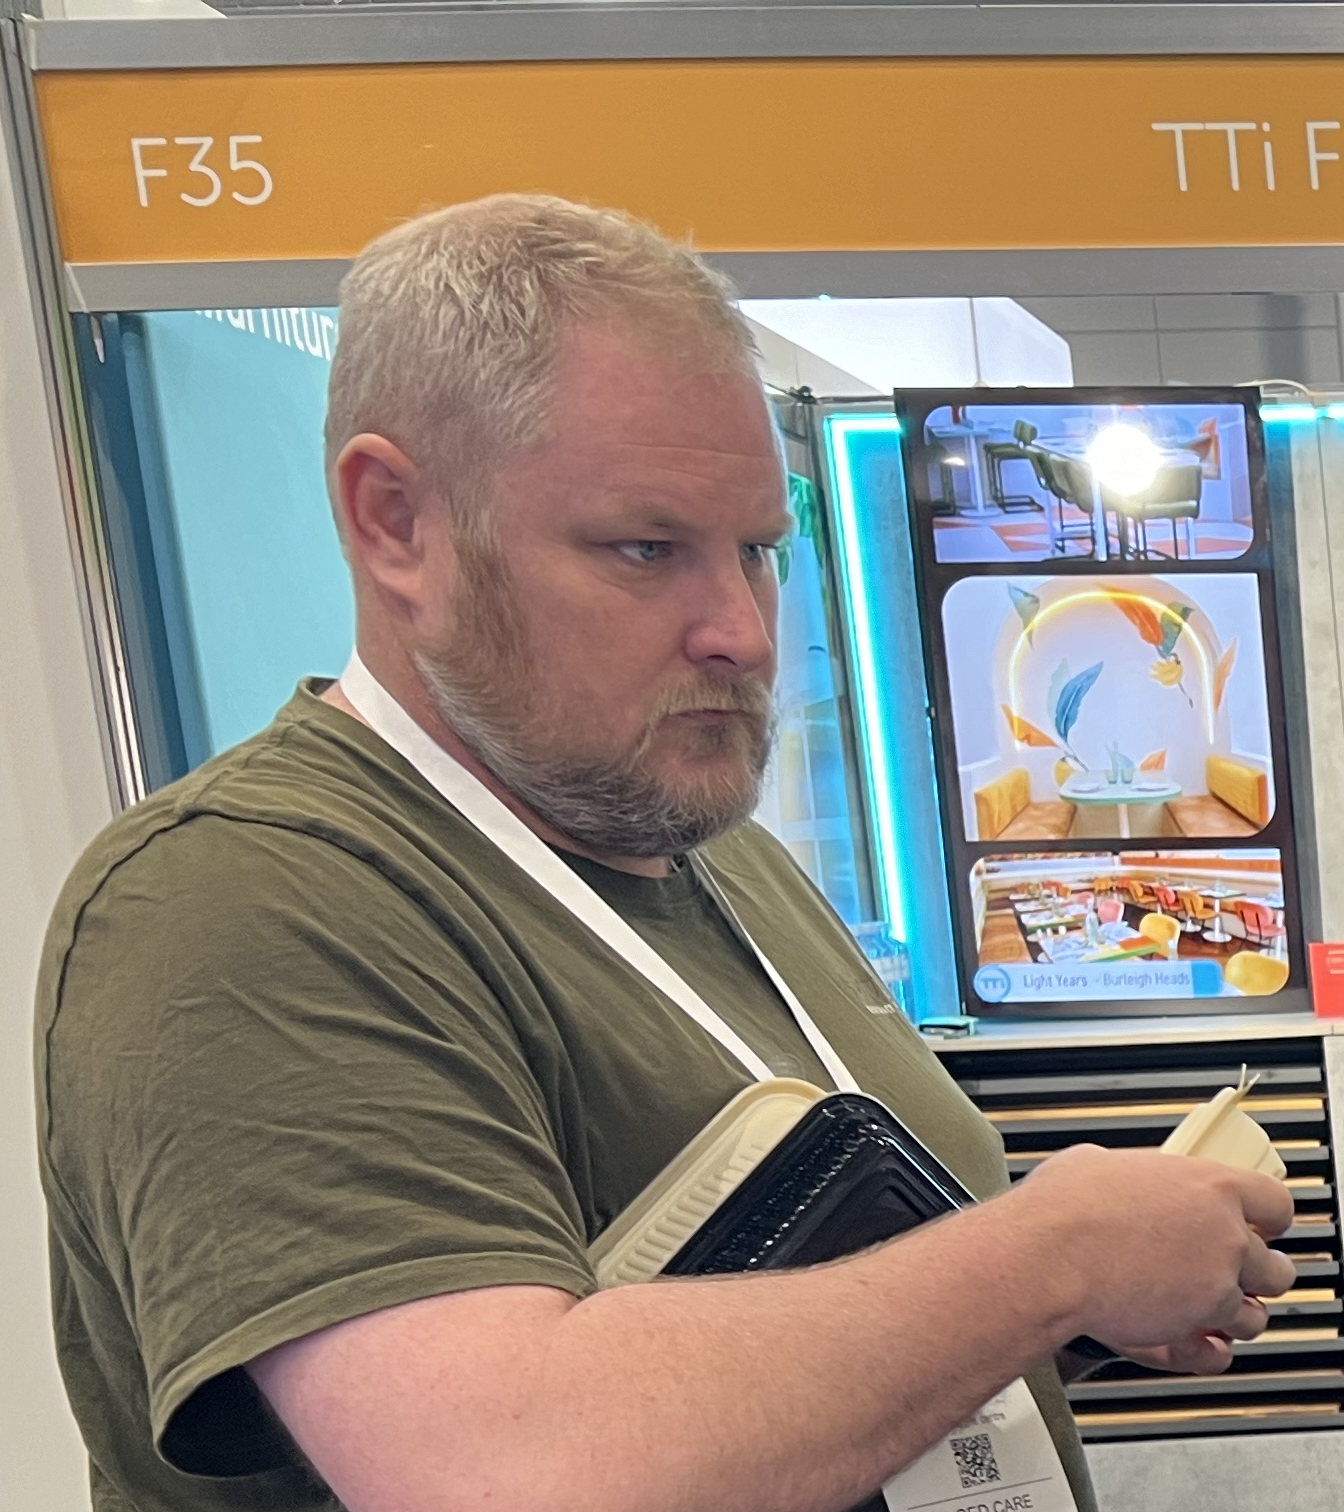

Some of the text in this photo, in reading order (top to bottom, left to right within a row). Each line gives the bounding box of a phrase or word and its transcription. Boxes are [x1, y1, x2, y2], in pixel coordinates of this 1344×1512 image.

[131, 135, 273, 207] F35
[1151, 121, 1276, 192] TTi
[1023, 975, 1053, 992] Light
[1056, 974, 1088, 988] Years
[1104, 972, 1151, 988] Burleigh
[1155, 971, 1191, 985] Heads
